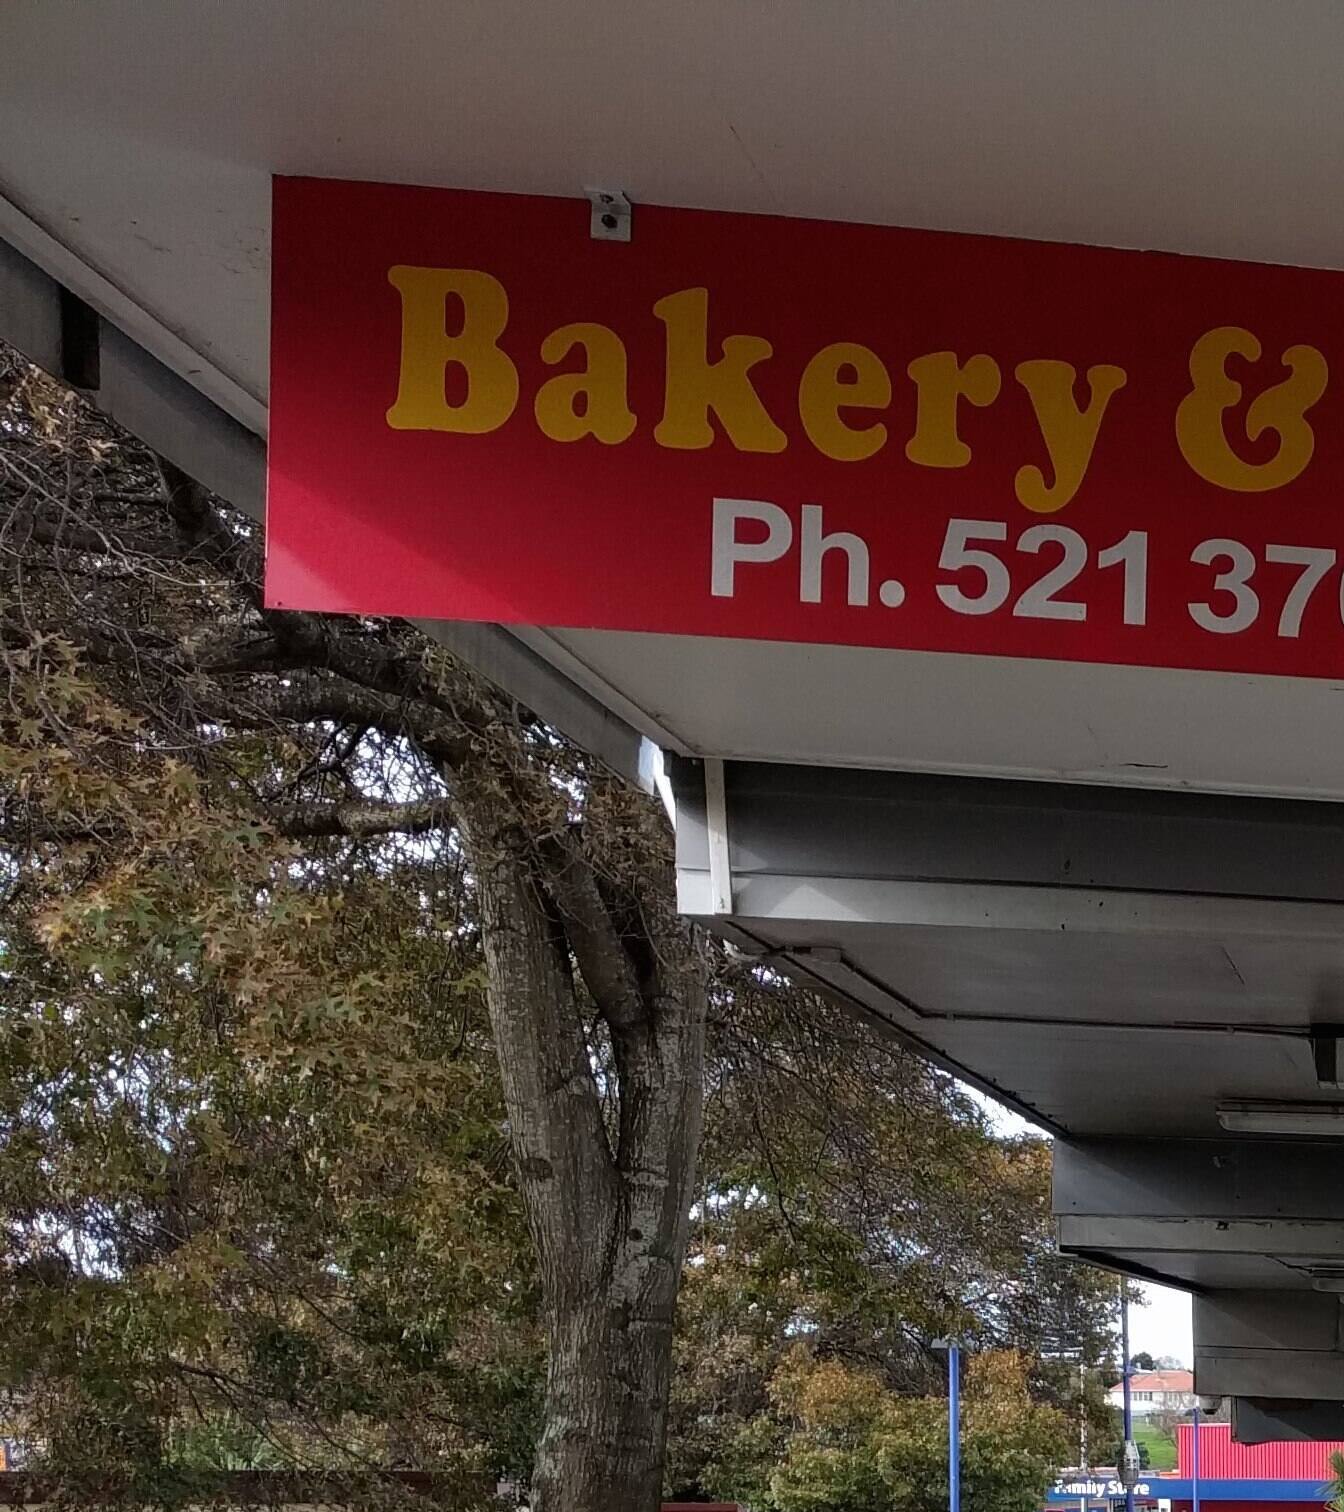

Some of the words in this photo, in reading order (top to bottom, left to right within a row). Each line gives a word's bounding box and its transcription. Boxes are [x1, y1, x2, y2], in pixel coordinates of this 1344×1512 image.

[385, 263, 1128, 515] Bakery
[1173, 325, 1332, 494] &
[708, 497, 906, 610] Ph.
[933, 517, 1151, 628] 521
